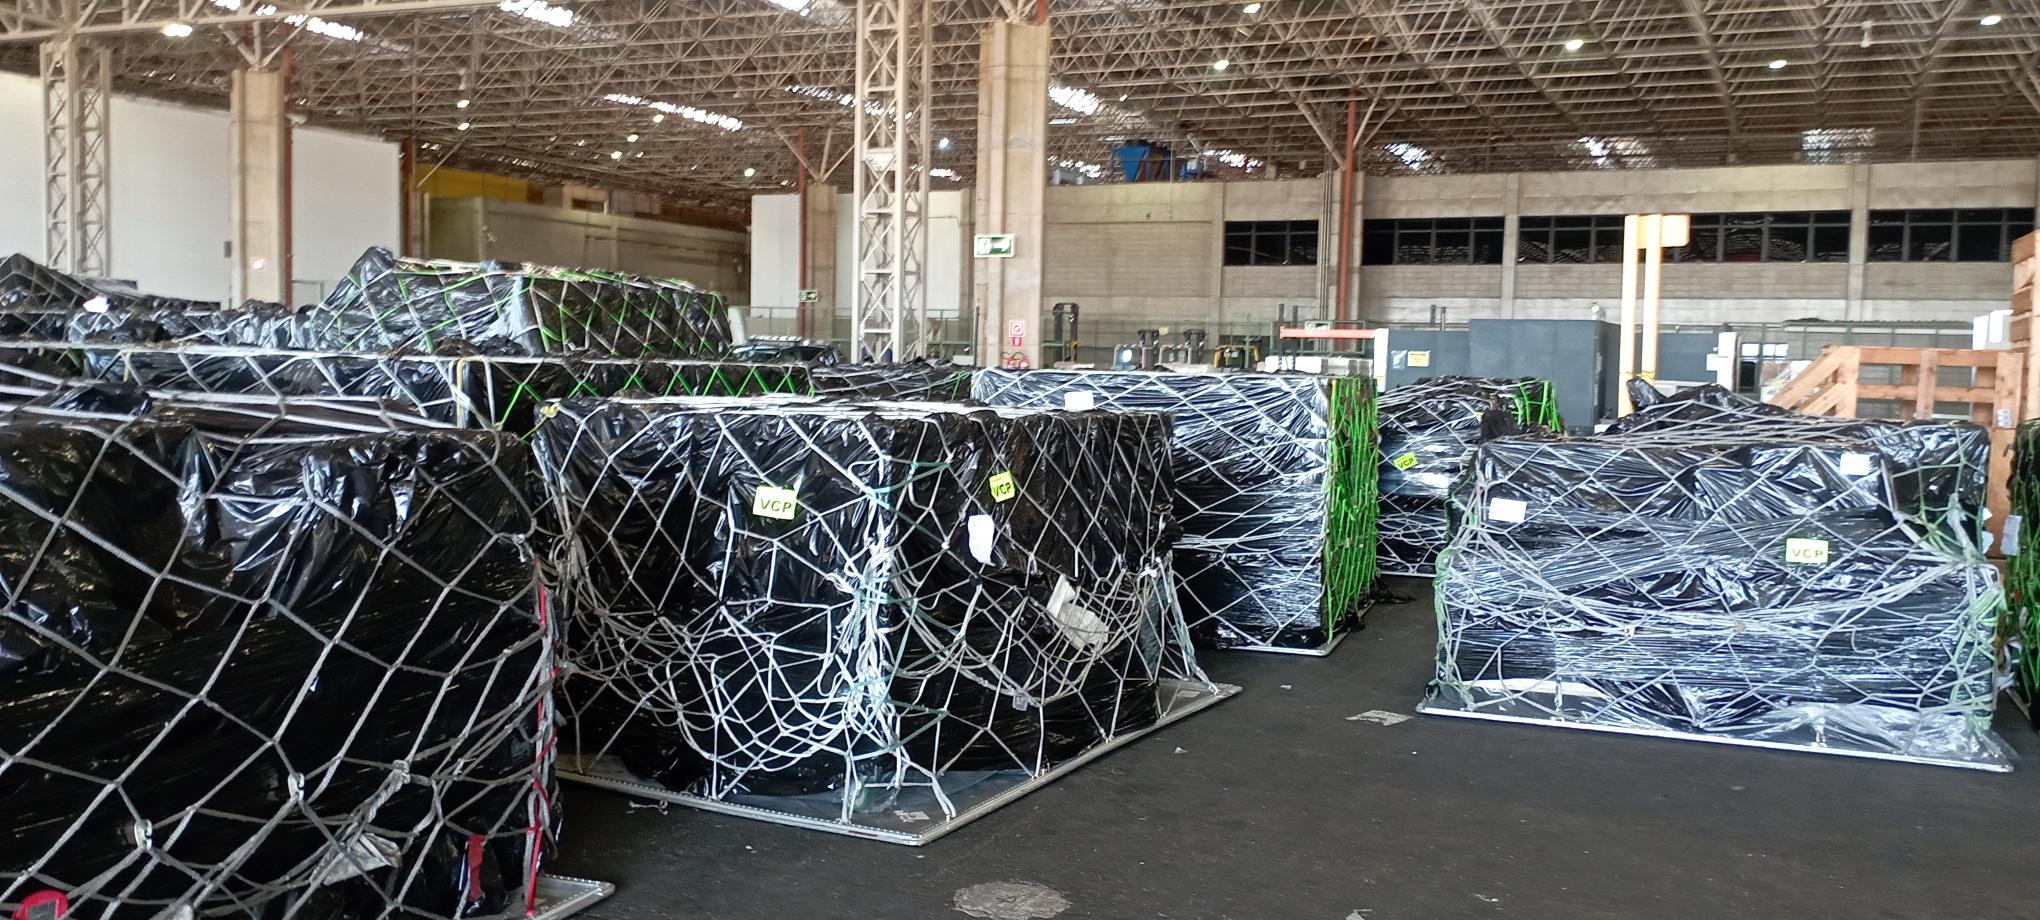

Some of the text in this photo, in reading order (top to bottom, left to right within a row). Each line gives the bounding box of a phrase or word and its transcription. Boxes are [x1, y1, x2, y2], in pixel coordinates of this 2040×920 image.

[1397, 457, 1414, 469] VCP
[992, 482, 1011, 497] VCP
[761, 498, 792, 513] VCP
[1792, 548, 1824, 558] VCP
